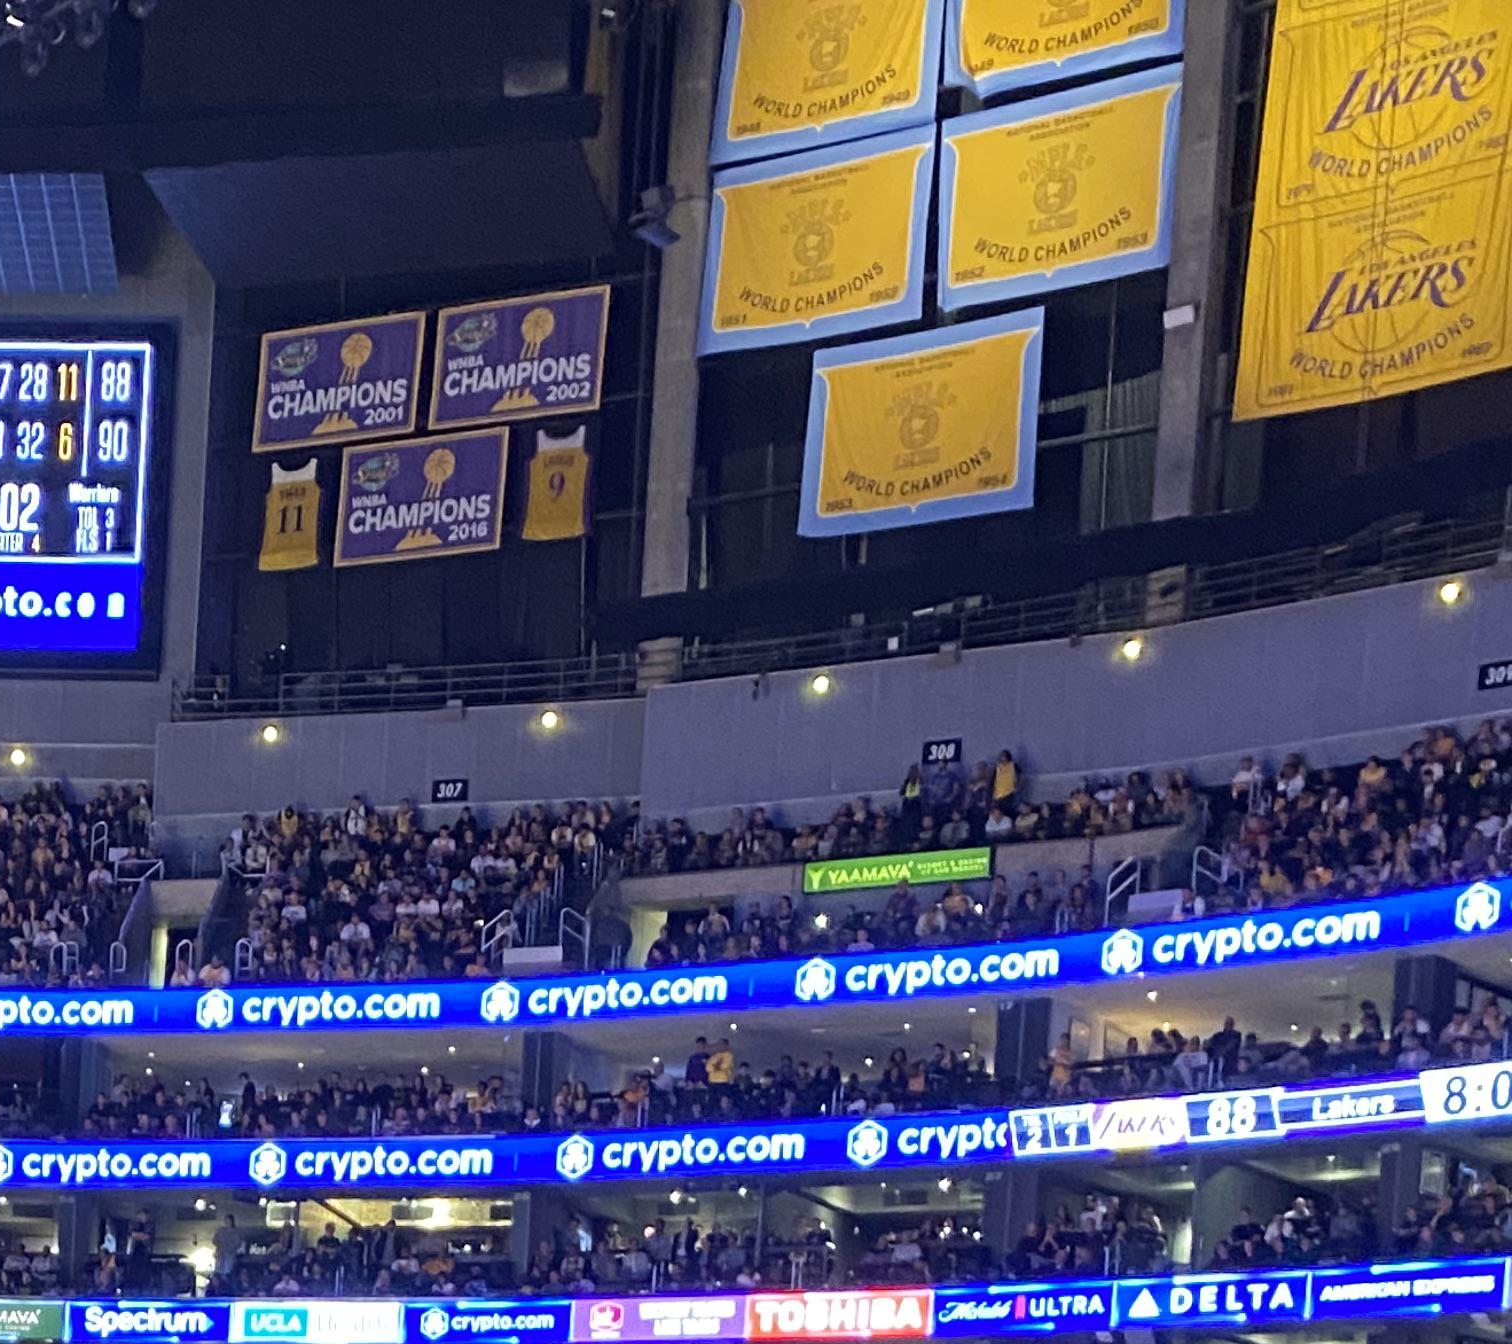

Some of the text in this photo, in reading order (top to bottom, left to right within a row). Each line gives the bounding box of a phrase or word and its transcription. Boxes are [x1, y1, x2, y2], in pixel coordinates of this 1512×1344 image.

[984, 31, 1040, 54] WORLD
[752, 91, 803, 119] WORLD
[807, 63, 897, 118] CHAMPIONS
[1308, 104, 1493, 179] WORLD CHAMPIONS
[973, 236, 1030, 263] WORLD
[1033, 205, 1132, 262] CHAMPIONS
[738, 260, 885, 314] WORLD CHAMPIONS
[1297, 256, 1476, 337] LAKERS
[1289, 311, 1476, 381] WORLD CHAMPIONS
[18, 361, 49, 401] 28
[56, 362, 79, 402] 11
[100, 361, 132, 402] 88
[443, 352, 592, 398] CHAMPIONS
[545, 380, 592, 402] 2002
[267, 377, 409, 421] CHAMPIONS
[363, 405, 404, 426] 2001
[15, 420, 45, 461] 32
[57, 421, 73, 462] 6
[97, 419, 129, 463] 90
[548, 471, 565, 500] 9
[843, 445, 993, 497] WORLD CHAMPIONS
[277, 503, 306, 535] 11
[348, 493, 491, 535] CHAMPIONS
[350, 493, 388, 509] WNBA
[30, 532, 42, 553] 4
[447, 521, 489, 541] 2016
[928, 742, 957, 761] 308
[436, 782, 463, 799] 307
[1152, 909, 1381, 966] crypto.com
[844, 946, 1060, 993] crypto.com
[242, 990, 441, 1026] crypto.com
[527, 973, 728, 1016] crypto.com
[1206, 1095, 1257, 1136] 88
[1311, 1095, 1396, 1120] Lakers
[21, 1148, 212, 1182] crypto.com
[295, 1144, 494, 1181] crypto.com
[601, 1131, 806, 1171] crypto.com
[754, 1297, 923, 1333] TOSHIBA
[1029, 1294, 1106, 1317] ULTRA
[1169, 1282, 1294, 1315] DELTA
[84, 1305, 207, 1338] Spectrum
[249, 1311, 304, 1333] UCLA
[451, 1312, 555, 1335] crypto.com
